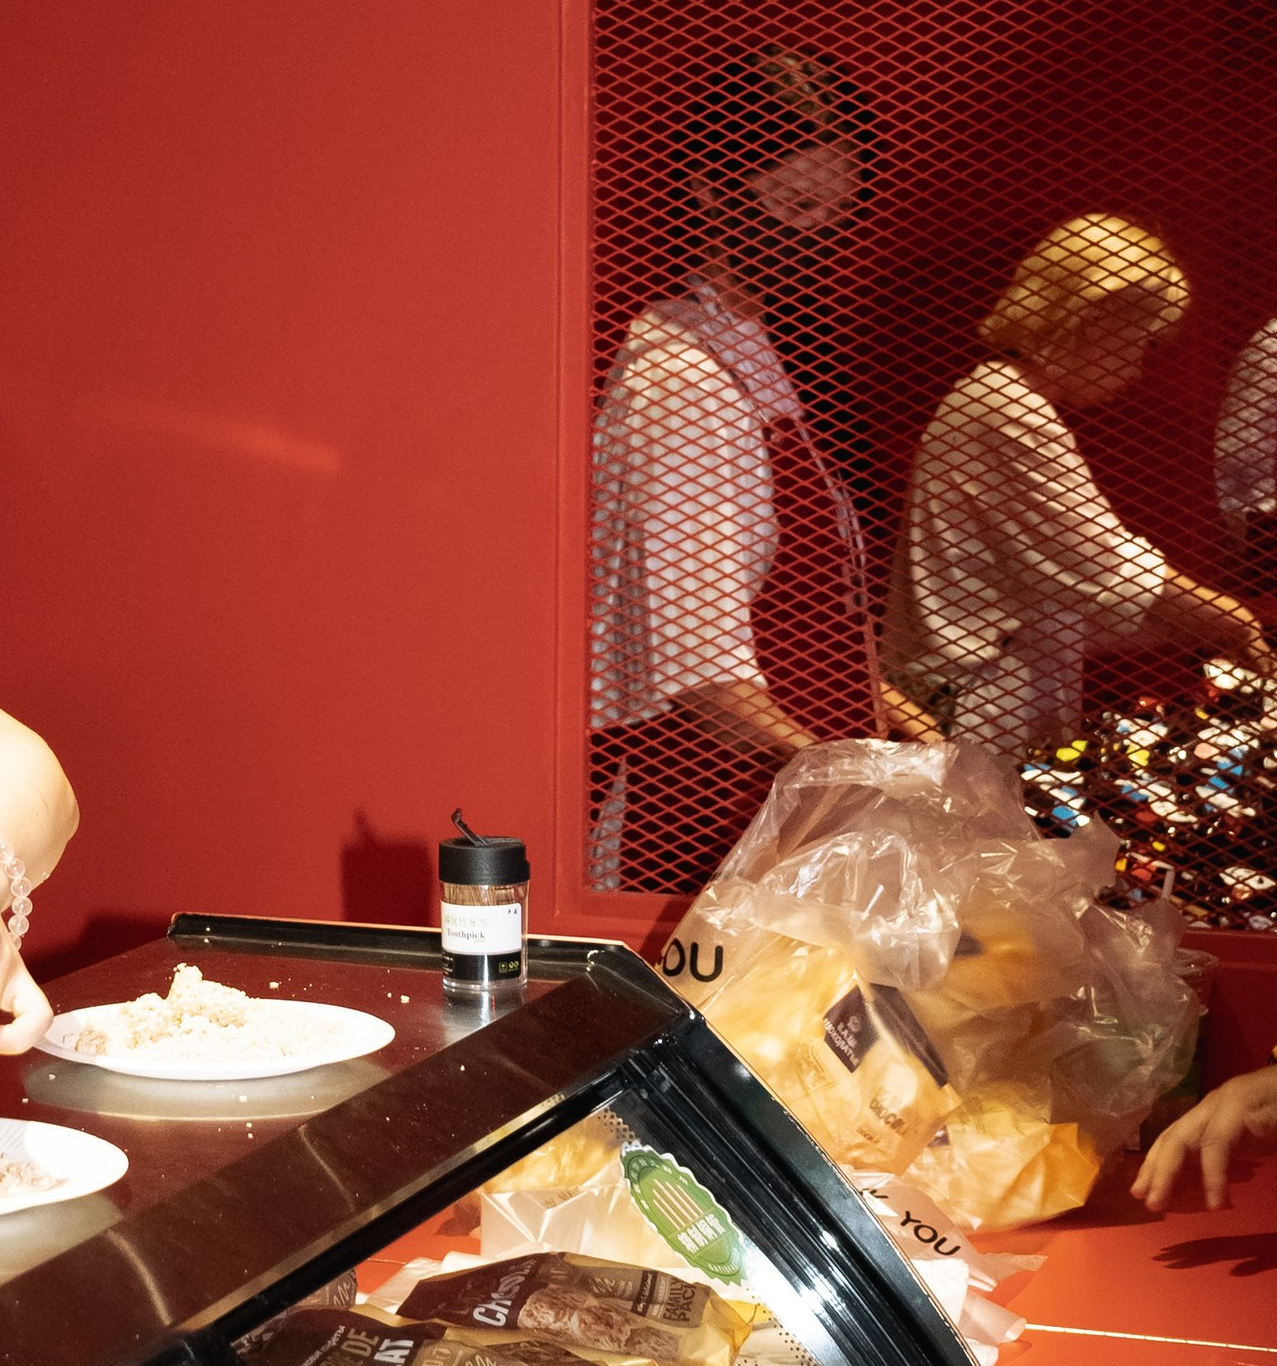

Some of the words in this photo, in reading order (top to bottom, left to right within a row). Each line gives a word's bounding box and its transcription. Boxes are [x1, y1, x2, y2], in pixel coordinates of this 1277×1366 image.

[446, 927, 486, 940] Toothpick
[659, 937, 724, 983] OU
[900, 1210, 962, 1256] YOU
[663, 1278, 684, 1322] FAMILY
[674, 1281, 697, 1324] PACK
[340, 1327, 381, 1357] DE
